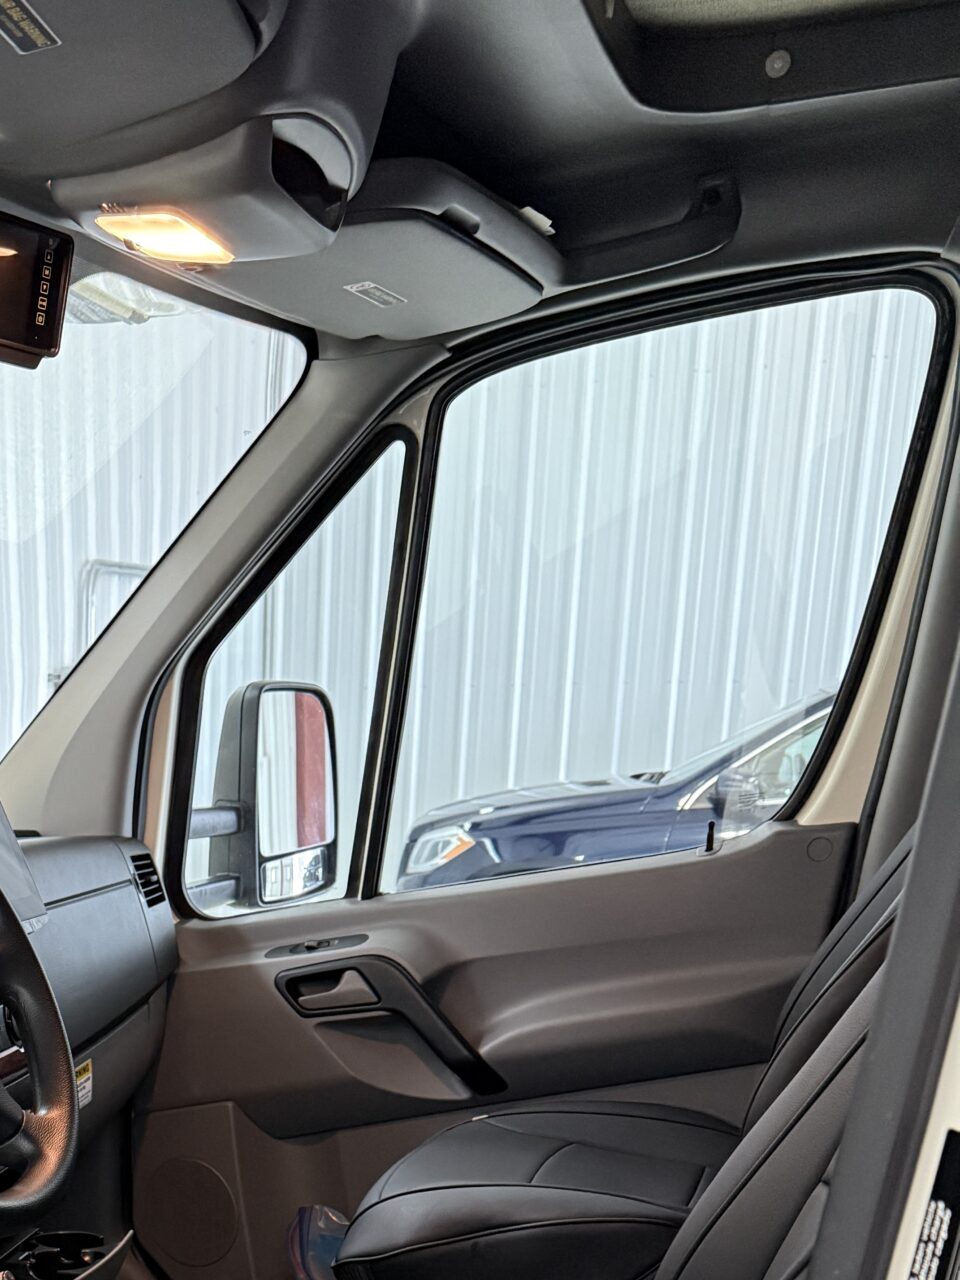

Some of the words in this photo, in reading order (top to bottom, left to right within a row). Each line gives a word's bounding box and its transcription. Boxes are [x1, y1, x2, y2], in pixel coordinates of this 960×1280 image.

[911, 1241, 926, 1274] laden
[920, 1200, 937, 1240] vehicle
[933, 1208, 953, 1255] cargado
